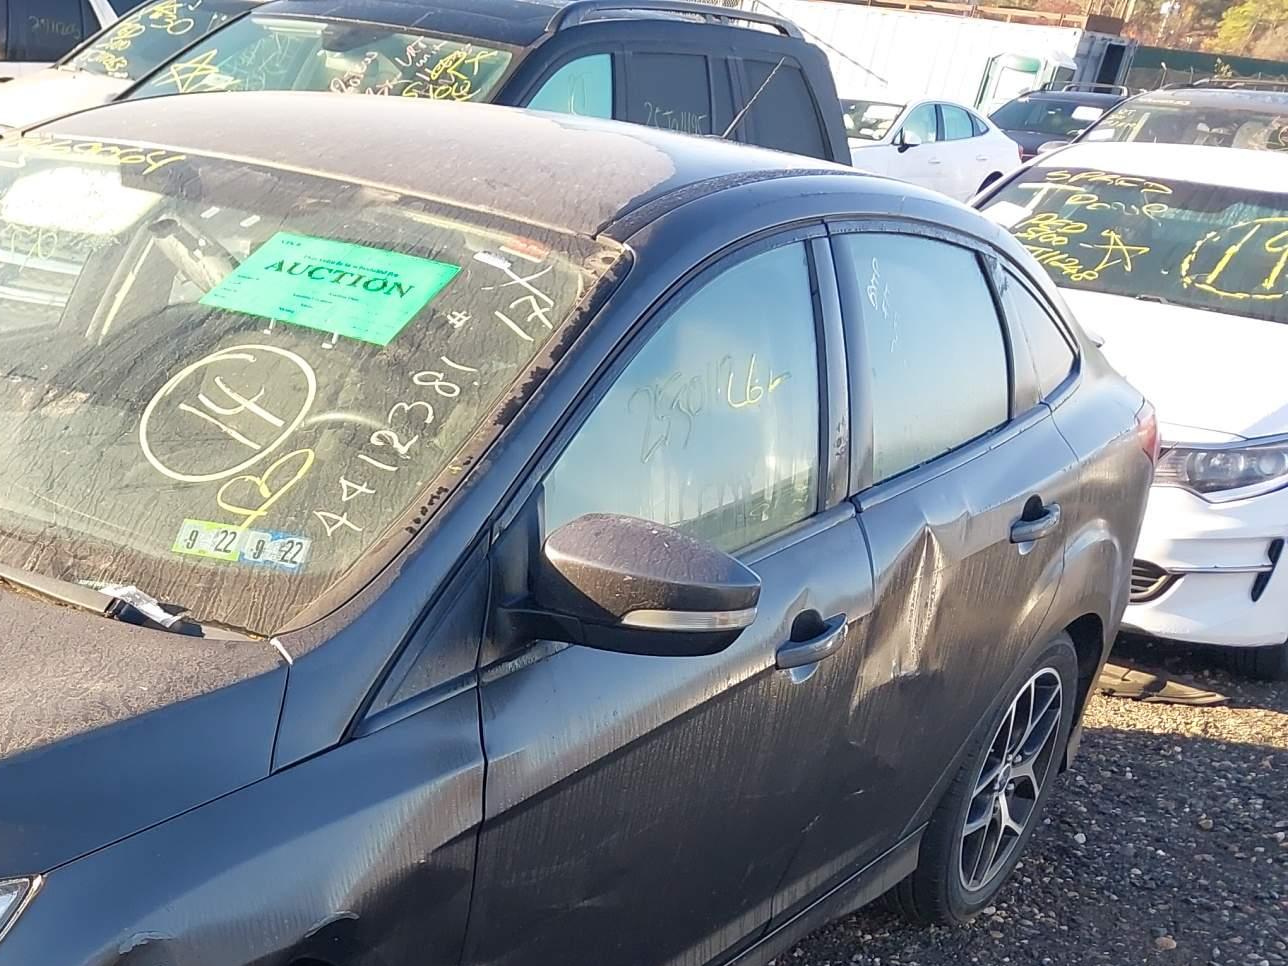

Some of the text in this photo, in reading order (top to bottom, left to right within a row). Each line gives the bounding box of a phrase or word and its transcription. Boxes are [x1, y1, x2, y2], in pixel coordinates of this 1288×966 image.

[264, 259, 415, 298] AUCTION
[213, 529, 238, 554] 22
[279, 539, 304, 565] 22
